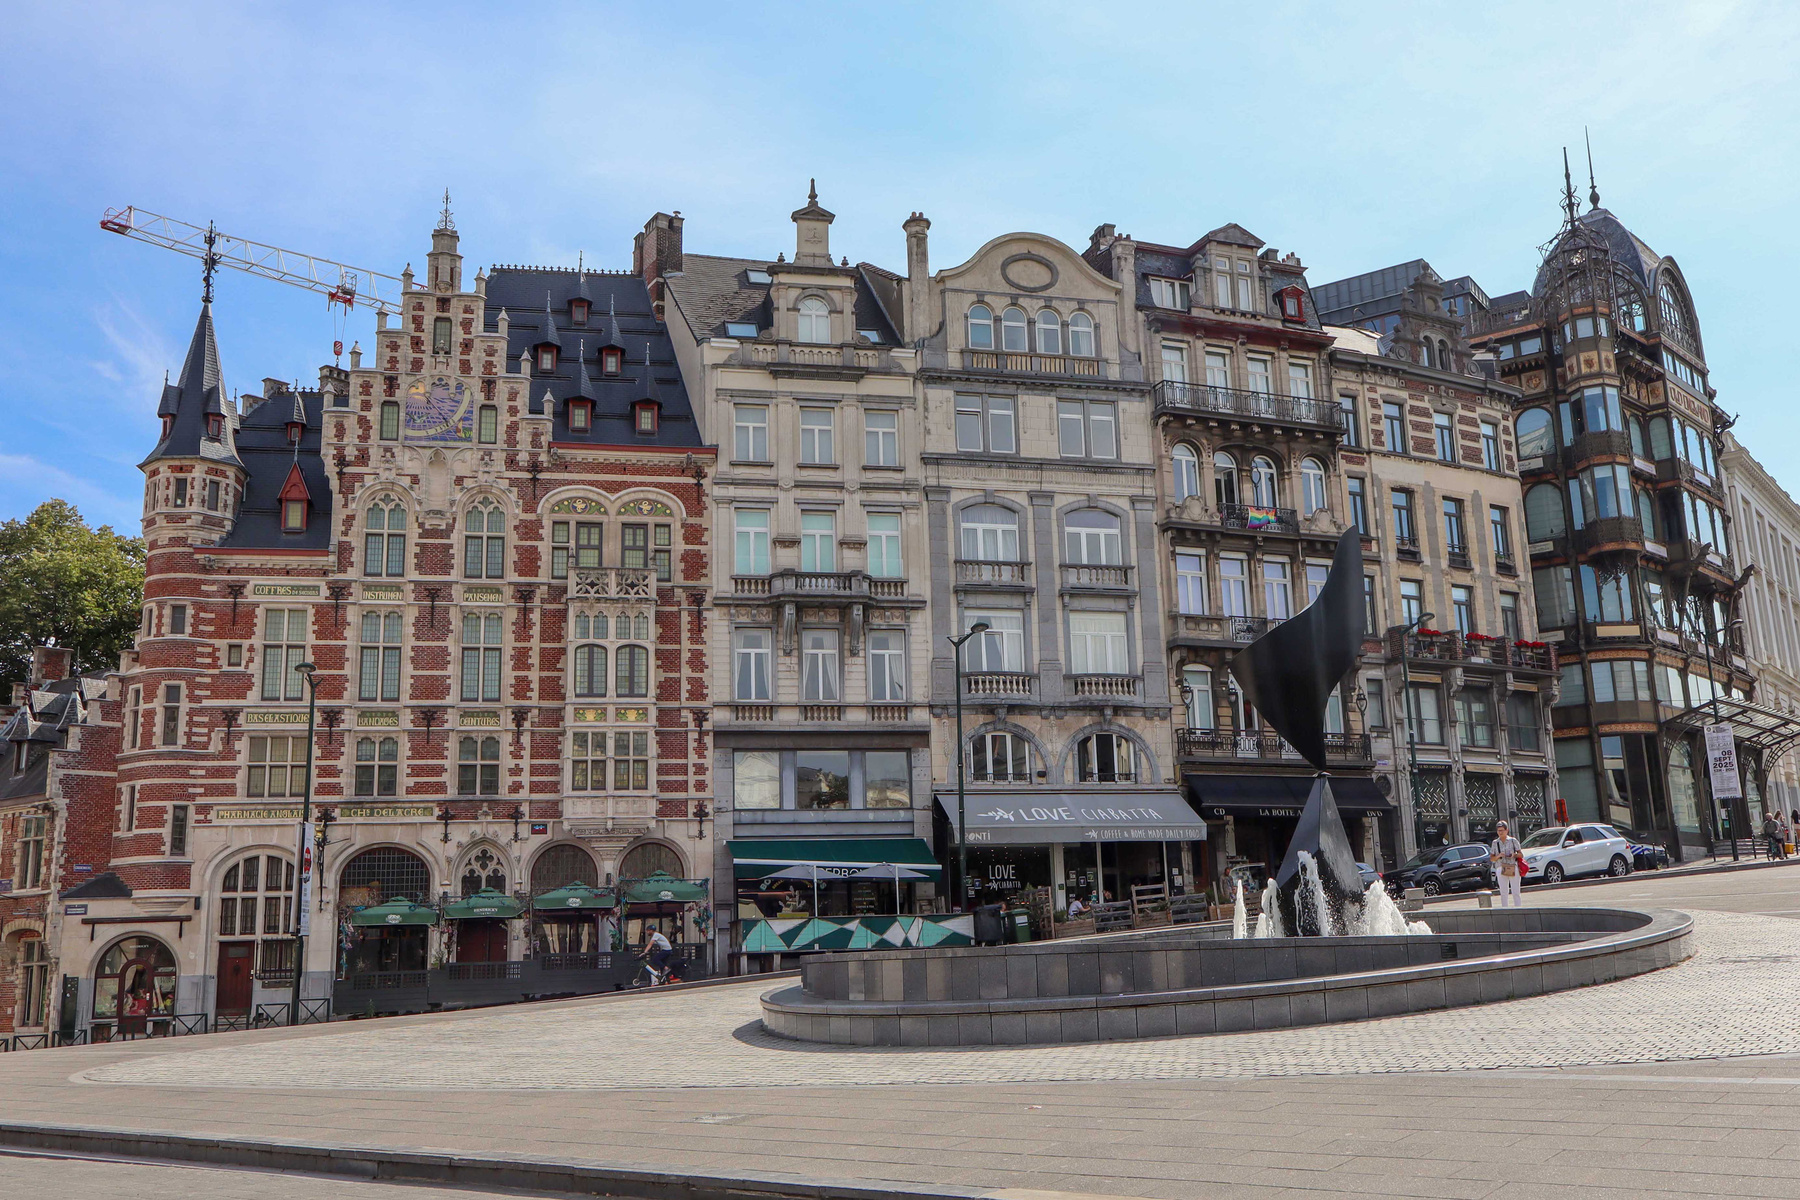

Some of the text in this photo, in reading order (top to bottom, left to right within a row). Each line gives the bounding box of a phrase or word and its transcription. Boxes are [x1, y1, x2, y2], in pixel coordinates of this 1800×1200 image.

[255, 585, 292, 595] COFFRES
[264, 713, 310, 723] ELASTIQUE
[358, 717, 399, 726] BANDAGES
[460, 717, 500, 726] CEINTURES
[218, 810, 269, 819] PHARMACIE
[374, 808, 424, 817] DELACRE
[1018, 806, 1163, 821] LOVE CIABATTA
[1259, 808, 1270, 816] LA
[1100, 829, 1122, 839] COFFEE
[1130, 829, 1146, 839] HOME
[1148, 829, 1164, 838] MADE
[1164, 829, 1184, 838] DAILY
[1185, 829, 1201, 838] FOOD
[989, 864, 1017, 880] LOVE
[999, 881, 1021, 889] CIABATTA
